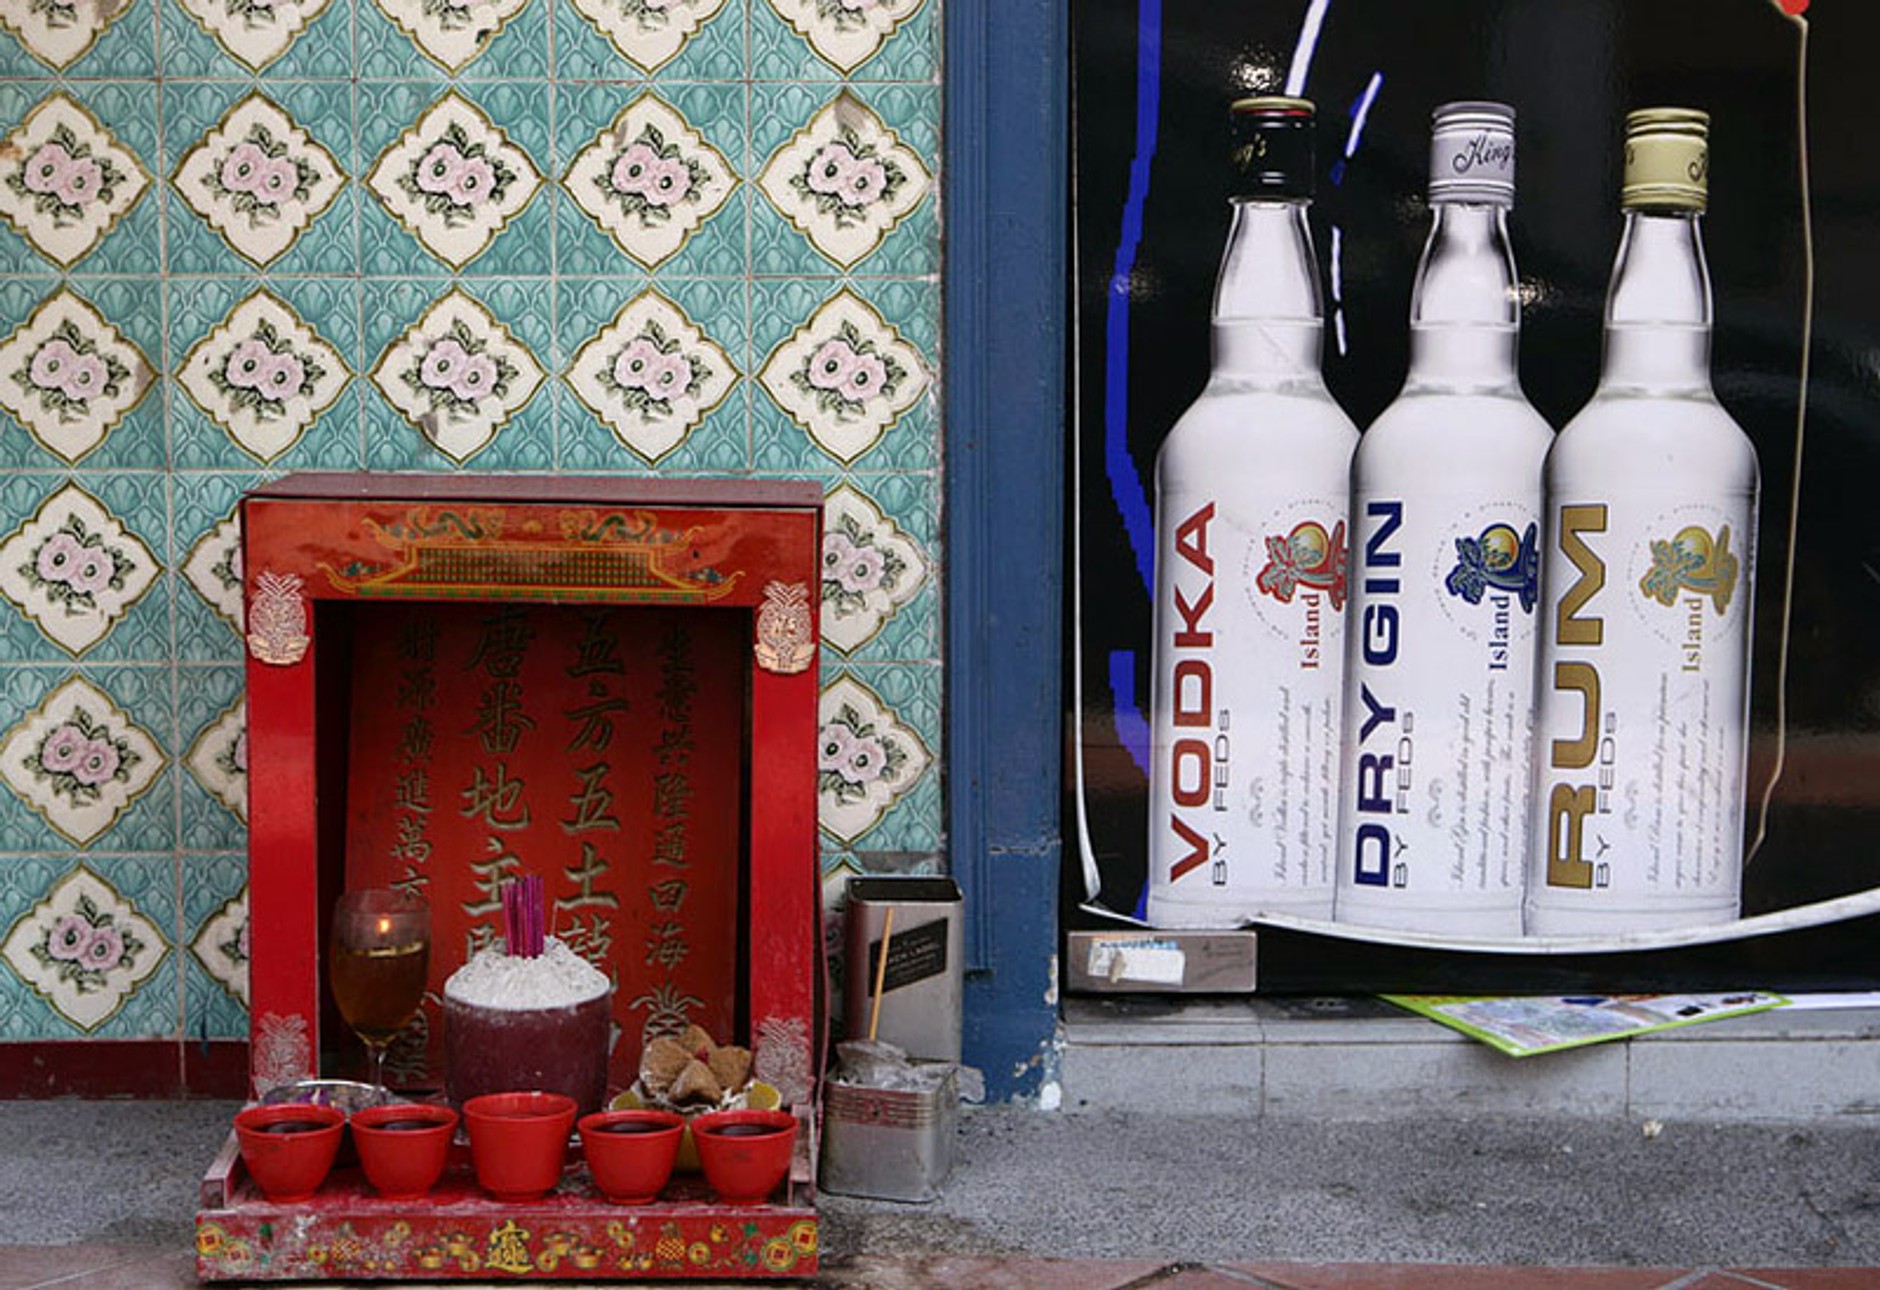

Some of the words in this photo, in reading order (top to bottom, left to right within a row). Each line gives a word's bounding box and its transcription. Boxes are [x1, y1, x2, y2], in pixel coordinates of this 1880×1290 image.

[1301, 594, 1320, 668] Island
[1363, 501, 1403, 666] GIN
[1488, 595, 1509, 670] Island
[1682, 599, 1702, 671] Island
[1170, 501, 1215, 883] VODKA
[1546, 503, 1608, 890] RUM
[1214, 709, 1230, 813] FEDS
[1354, 682, 1396, 888] DRY
[1396, 711, 1414, 814] FEDS
[1598, 711, 1616, 814] FEDS
[1213, 832, 1227, 886] BY
[1393, 835, 1409, 889] BY
[1596, 835, 1612, 889] BY
